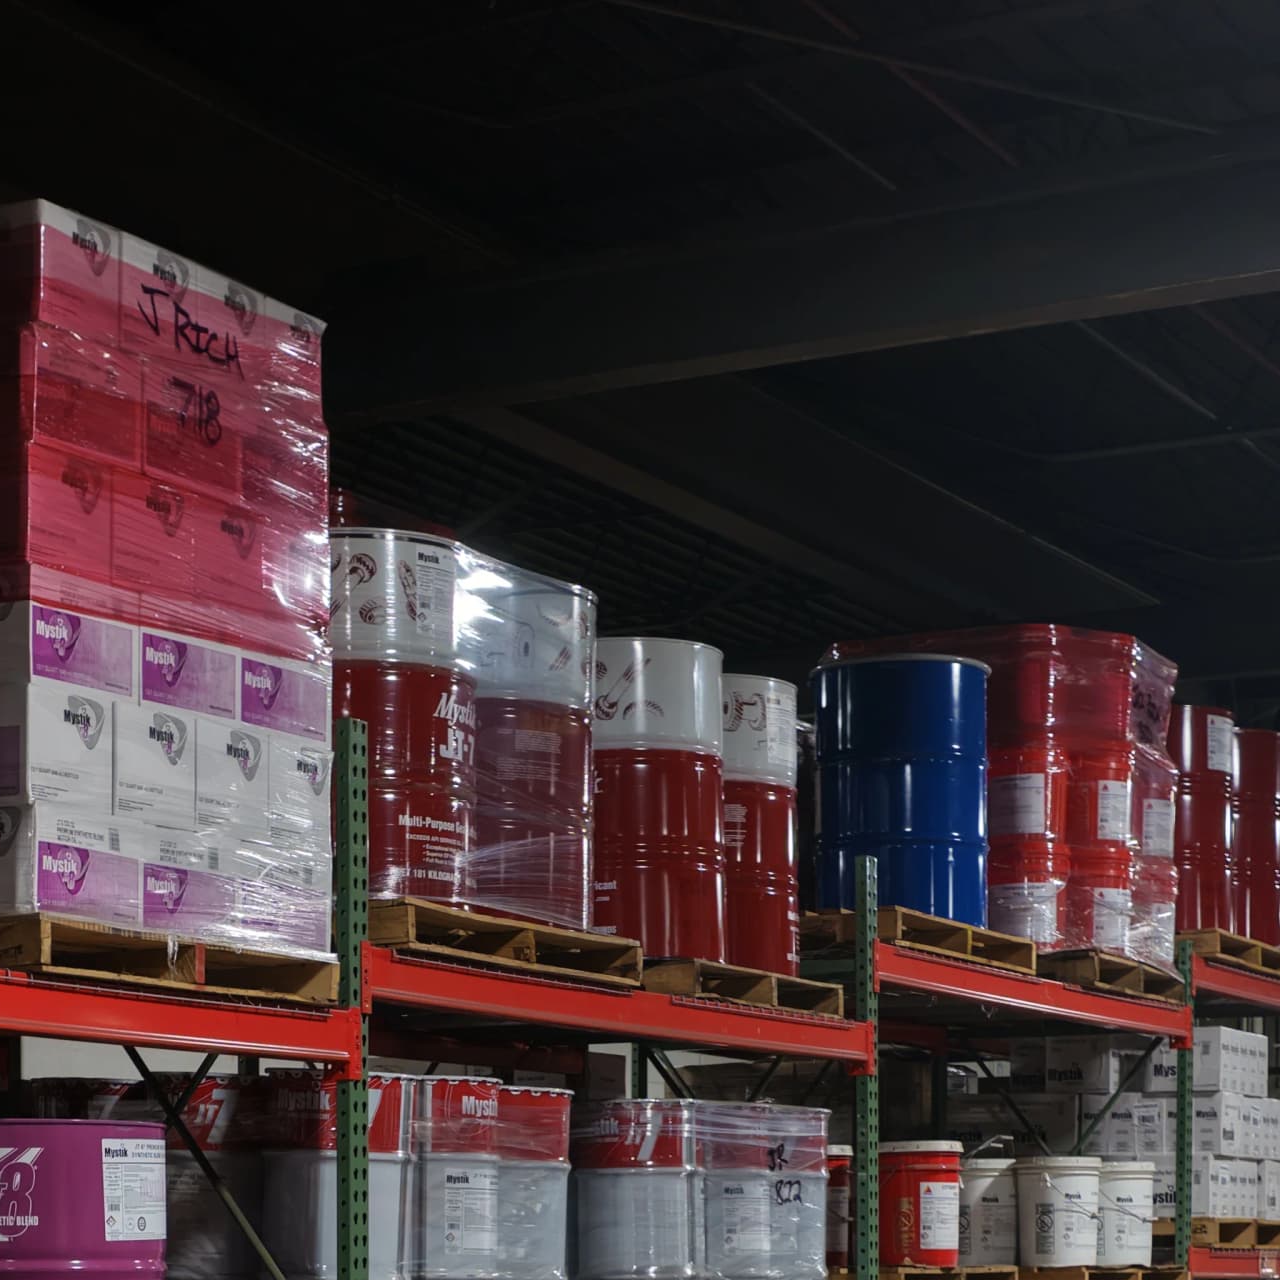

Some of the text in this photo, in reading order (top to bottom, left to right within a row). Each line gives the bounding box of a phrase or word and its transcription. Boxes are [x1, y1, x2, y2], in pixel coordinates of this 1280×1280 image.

[35, 618, 69, 641] Mystik
[145, 645, 177, 668] Mystik
[244, 669, 273, 692] Mystik
[63, 708, 92, 729] Mystik
[149, 725, 176, 746] Mystik
[226, 741, 251, 763] Mystik
[398, 814, 456, 833] Multi-Purpose
[42, 854, 78, 875] Mystik
[1154, 1062, 1177, 1078] Mys
[104, 1147, 128, 1158] Mystik
[445, 1174, 470, 1185] Mystik
[16, 1215, 39, 1227] BLEND
